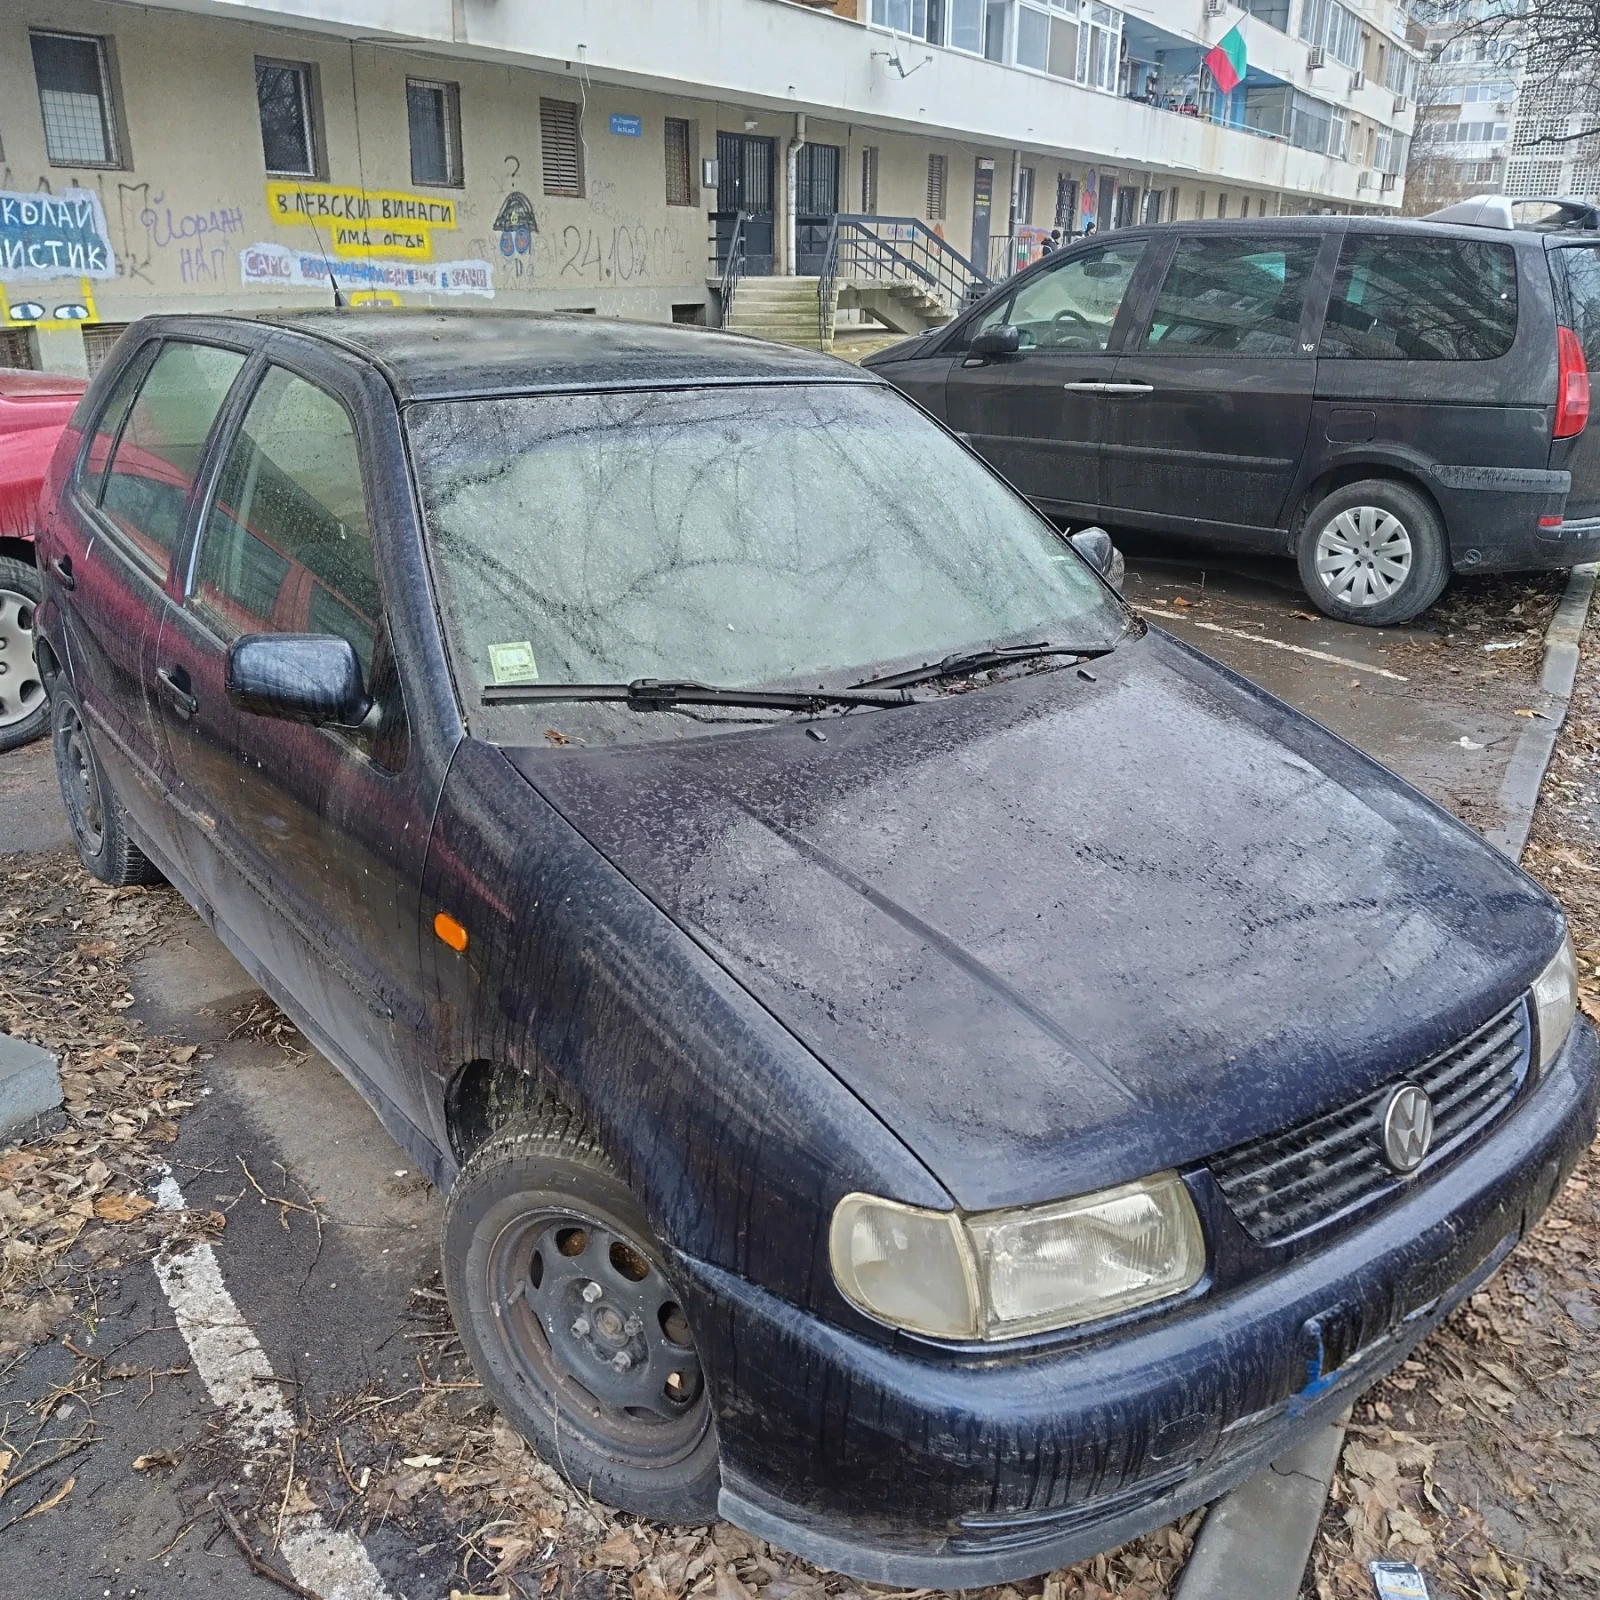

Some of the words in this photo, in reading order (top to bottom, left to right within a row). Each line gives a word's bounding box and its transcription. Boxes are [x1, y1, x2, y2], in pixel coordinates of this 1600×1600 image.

[277, 193, 288, 214] В
[382, 199, 452, 222] ВИНАГИ
[336, 228, 371, 246] ИМА
[0, 239, 106, 271] ИСТИК
[245, 251, 292, 278] САМО
[1302, 343, 1316, 352] V6
